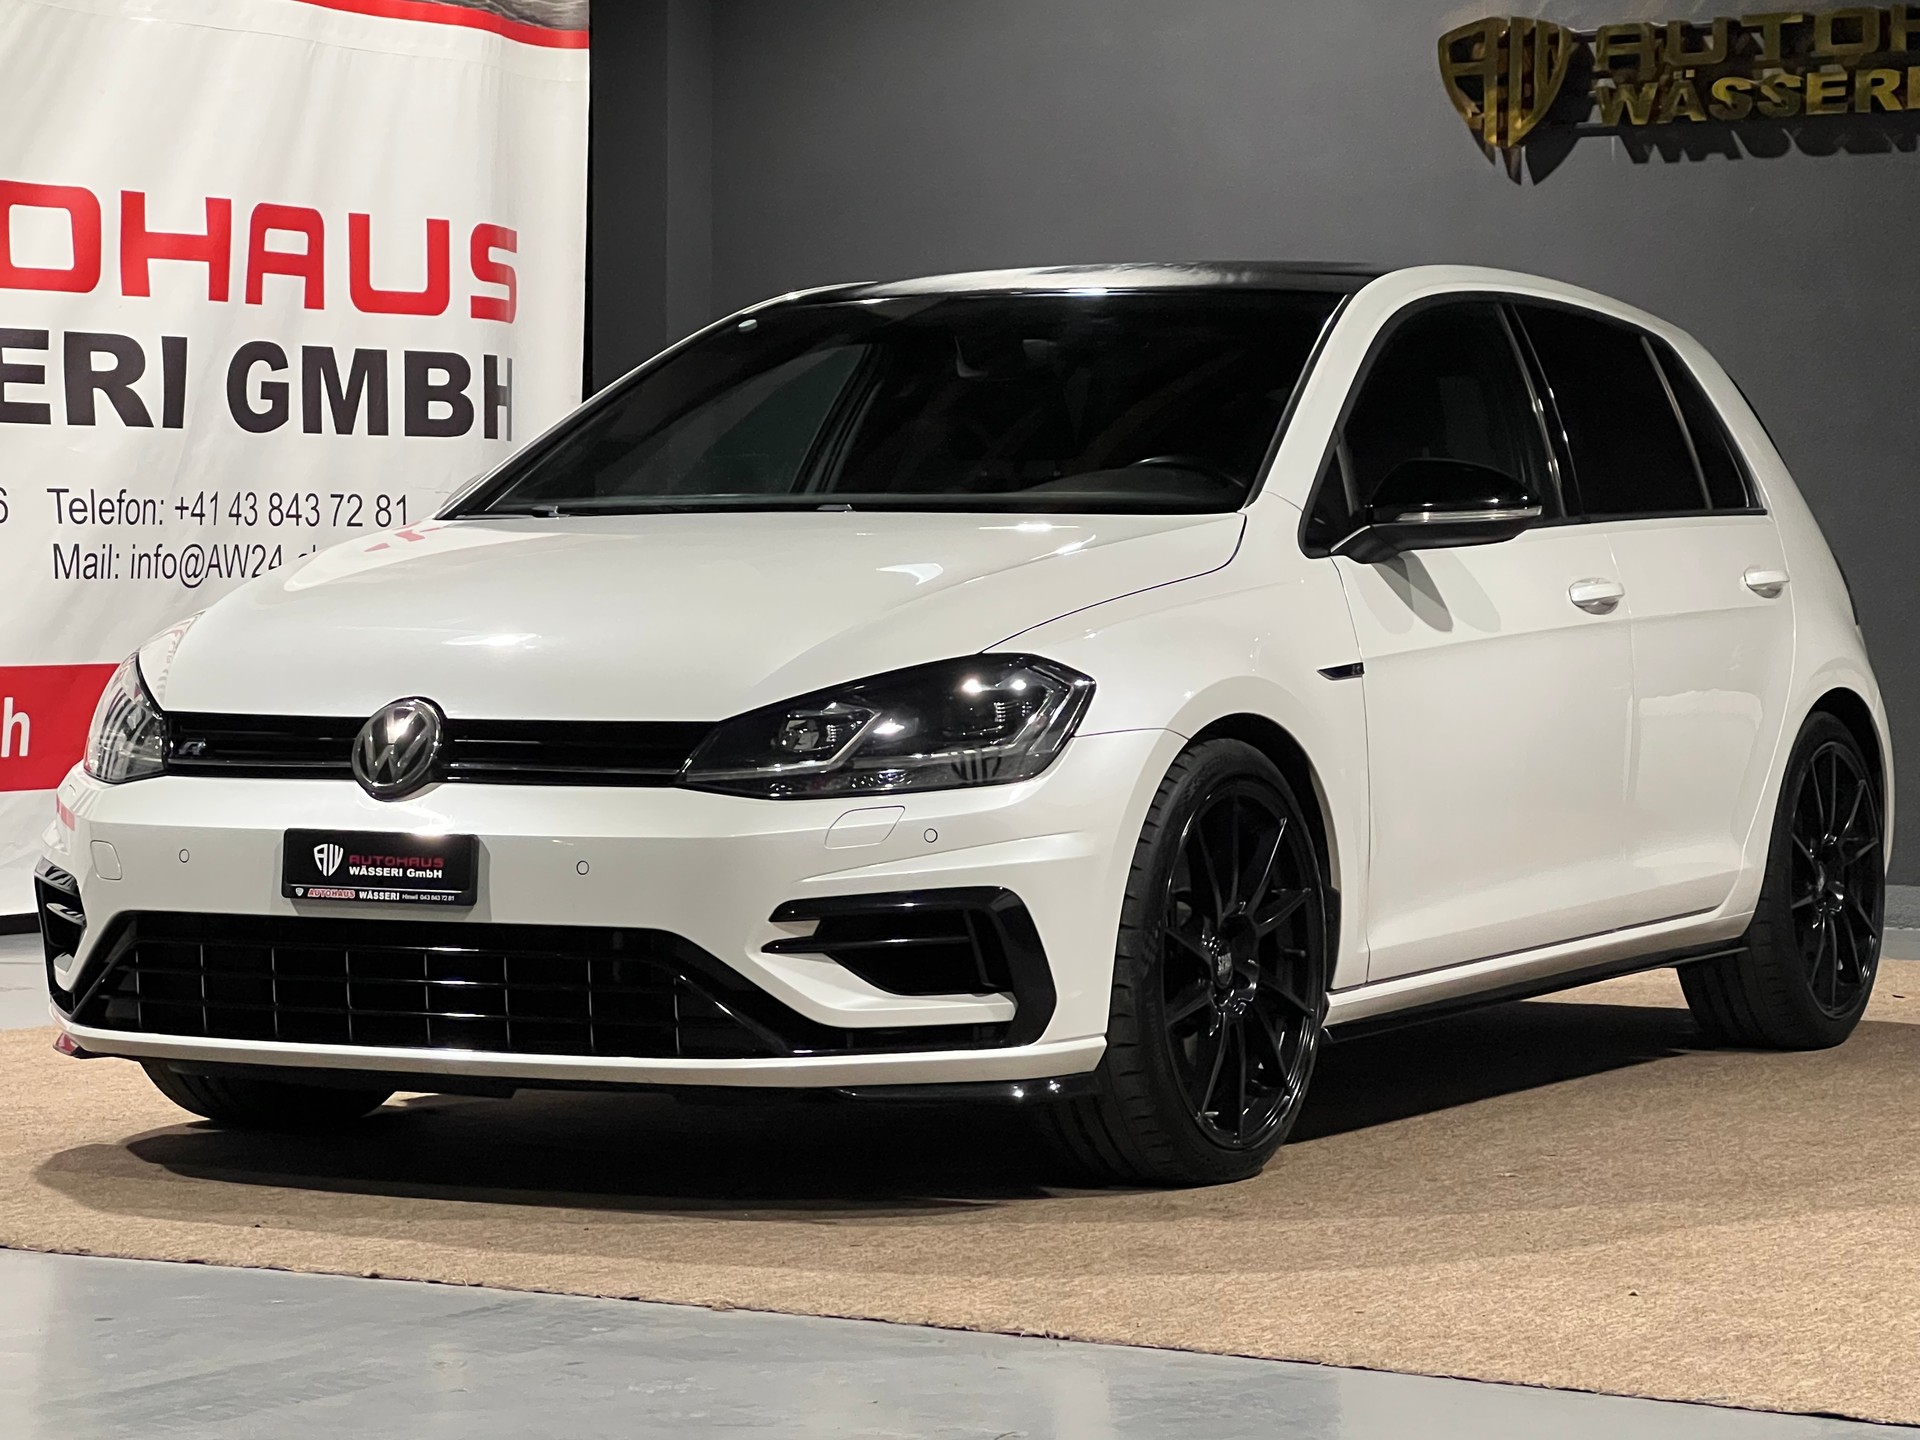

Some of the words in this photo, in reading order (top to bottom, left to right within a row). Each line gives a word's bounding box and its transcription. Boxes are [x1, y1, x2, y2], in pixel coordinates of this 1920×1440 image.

[0, 180, 518, 324] OHAUS
[226, 340, 513, 442] GMBH
[46, 488, 165, 526] Telefon:
[174, 490, 219, 526] +41
[228, 491, 258, 526] 43
[268, 492, 320, 527] 843
[330, 493, 363, 527] 72
[375, 493, 407, 527] 81
[53, 543, 120, 580] Mail:
[348, 854, 445, 868] AUTOHAUS
[349, 865, 403, 877] WÄSSERI
[406, 868, 443, 879] GmbH
[307, 887, 356, 899] AUTOHAUS
[359, 890, 400, 901] WÄSSERI
